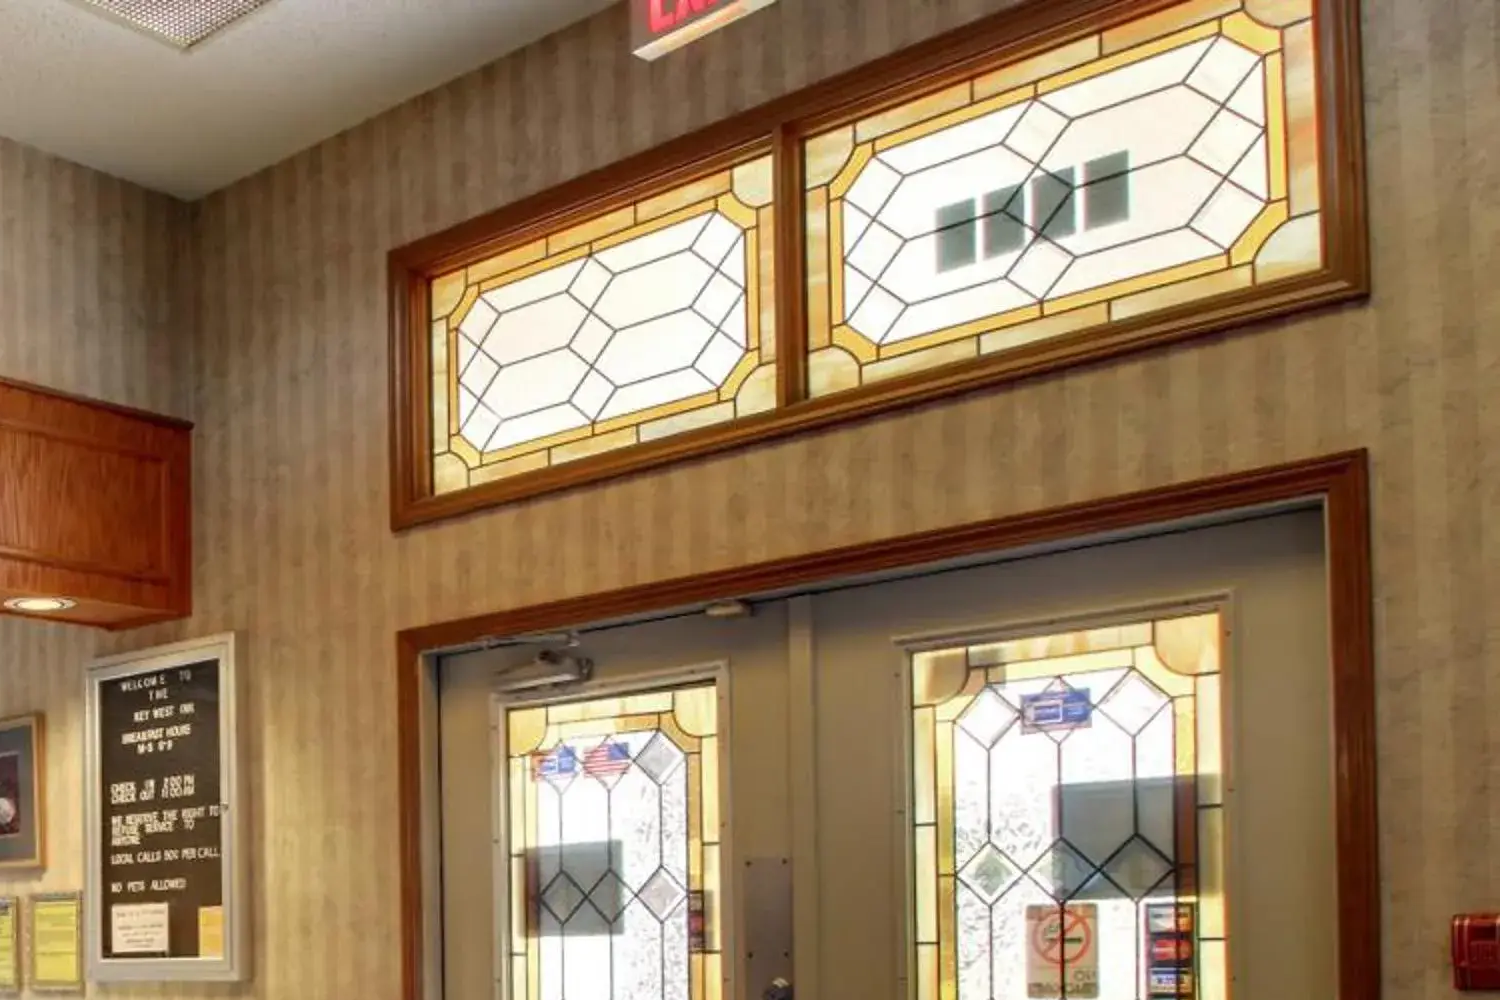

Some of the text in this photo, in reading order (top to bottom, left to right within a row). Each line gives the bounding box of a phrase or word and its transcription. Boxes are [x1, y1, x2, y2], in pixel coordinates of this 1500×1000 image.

[121, 674, 165, 692] WELCOME
[149, 688, 168, 701] THE
[133, 709, 150, 722] KEY
[152, 705, 175, 719] WEST
[121, 723, 192, 745] BREAKFAST HOURS
[162, 809, 179, 821] THE
[184, 818, 195, 831] TO
[111, 853, 134, 865] LOCAL
[137, 849, 161, 863] CALLS
[111, 877, 187, 893] NO PETS ALLOWED
